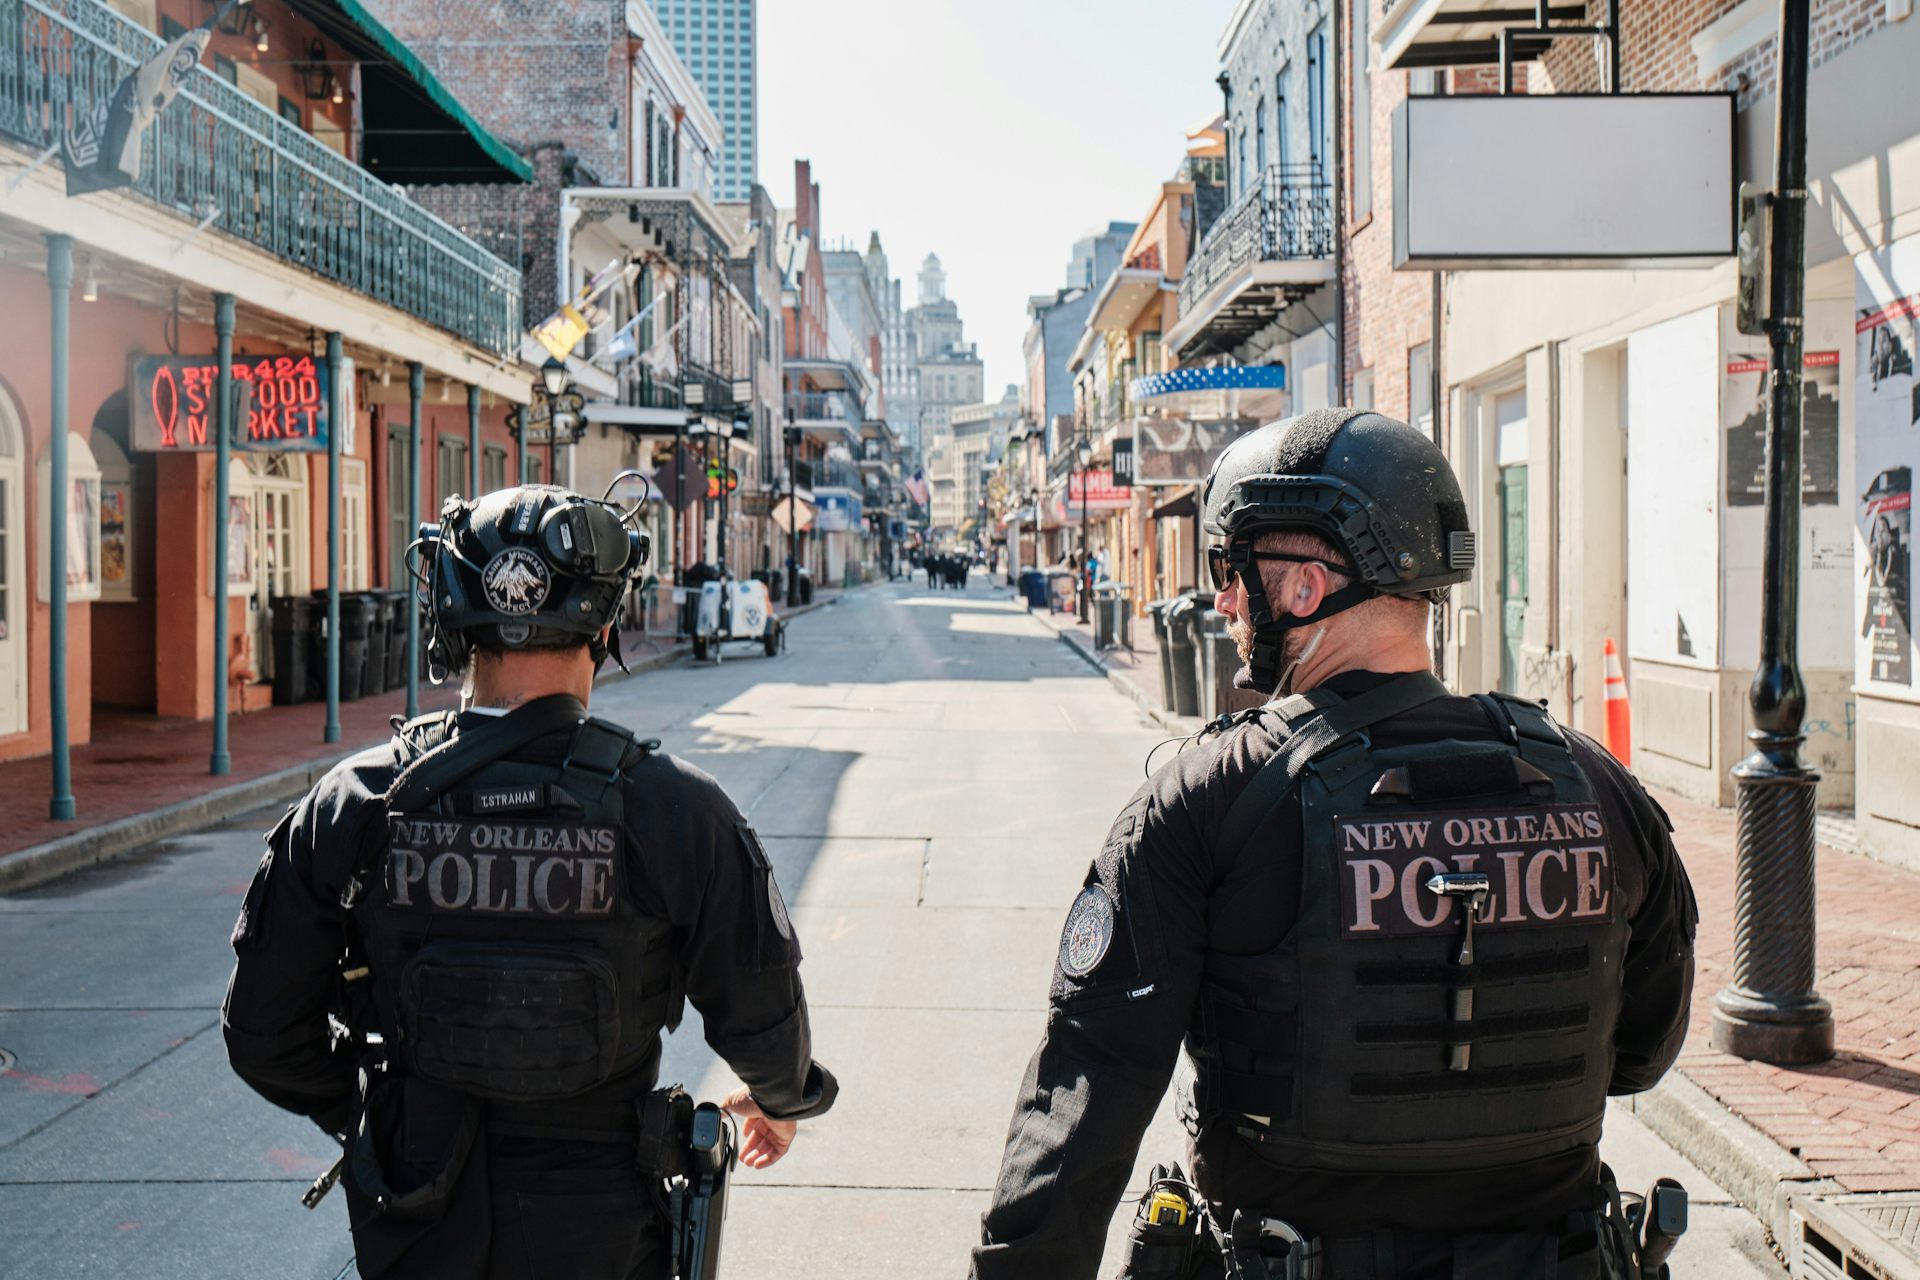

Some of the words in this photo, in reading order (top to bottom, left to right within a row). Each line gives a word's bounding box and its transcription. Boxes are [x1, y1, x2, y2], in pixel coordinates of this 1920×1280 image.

[182, 364, 253, 385] PIR
[186, 375, 320, 414] SOOD
[187, 406, 321, 445] MRKET
[486, 557, 504, 584] SAINT
[508, 551, 545, 579] MICHAEL
[489, 590, 531, 613] PROTECT
[533, 586, 545, 601] US
[392, 820, 462, 846] NEW
[469, 824, 616, 854] ORLEANS
[1342, 821, 1431, 852] NEW
[1443, 811, 1604, 847] ORLEANS
[391, 849, 614, 915] POLICE
